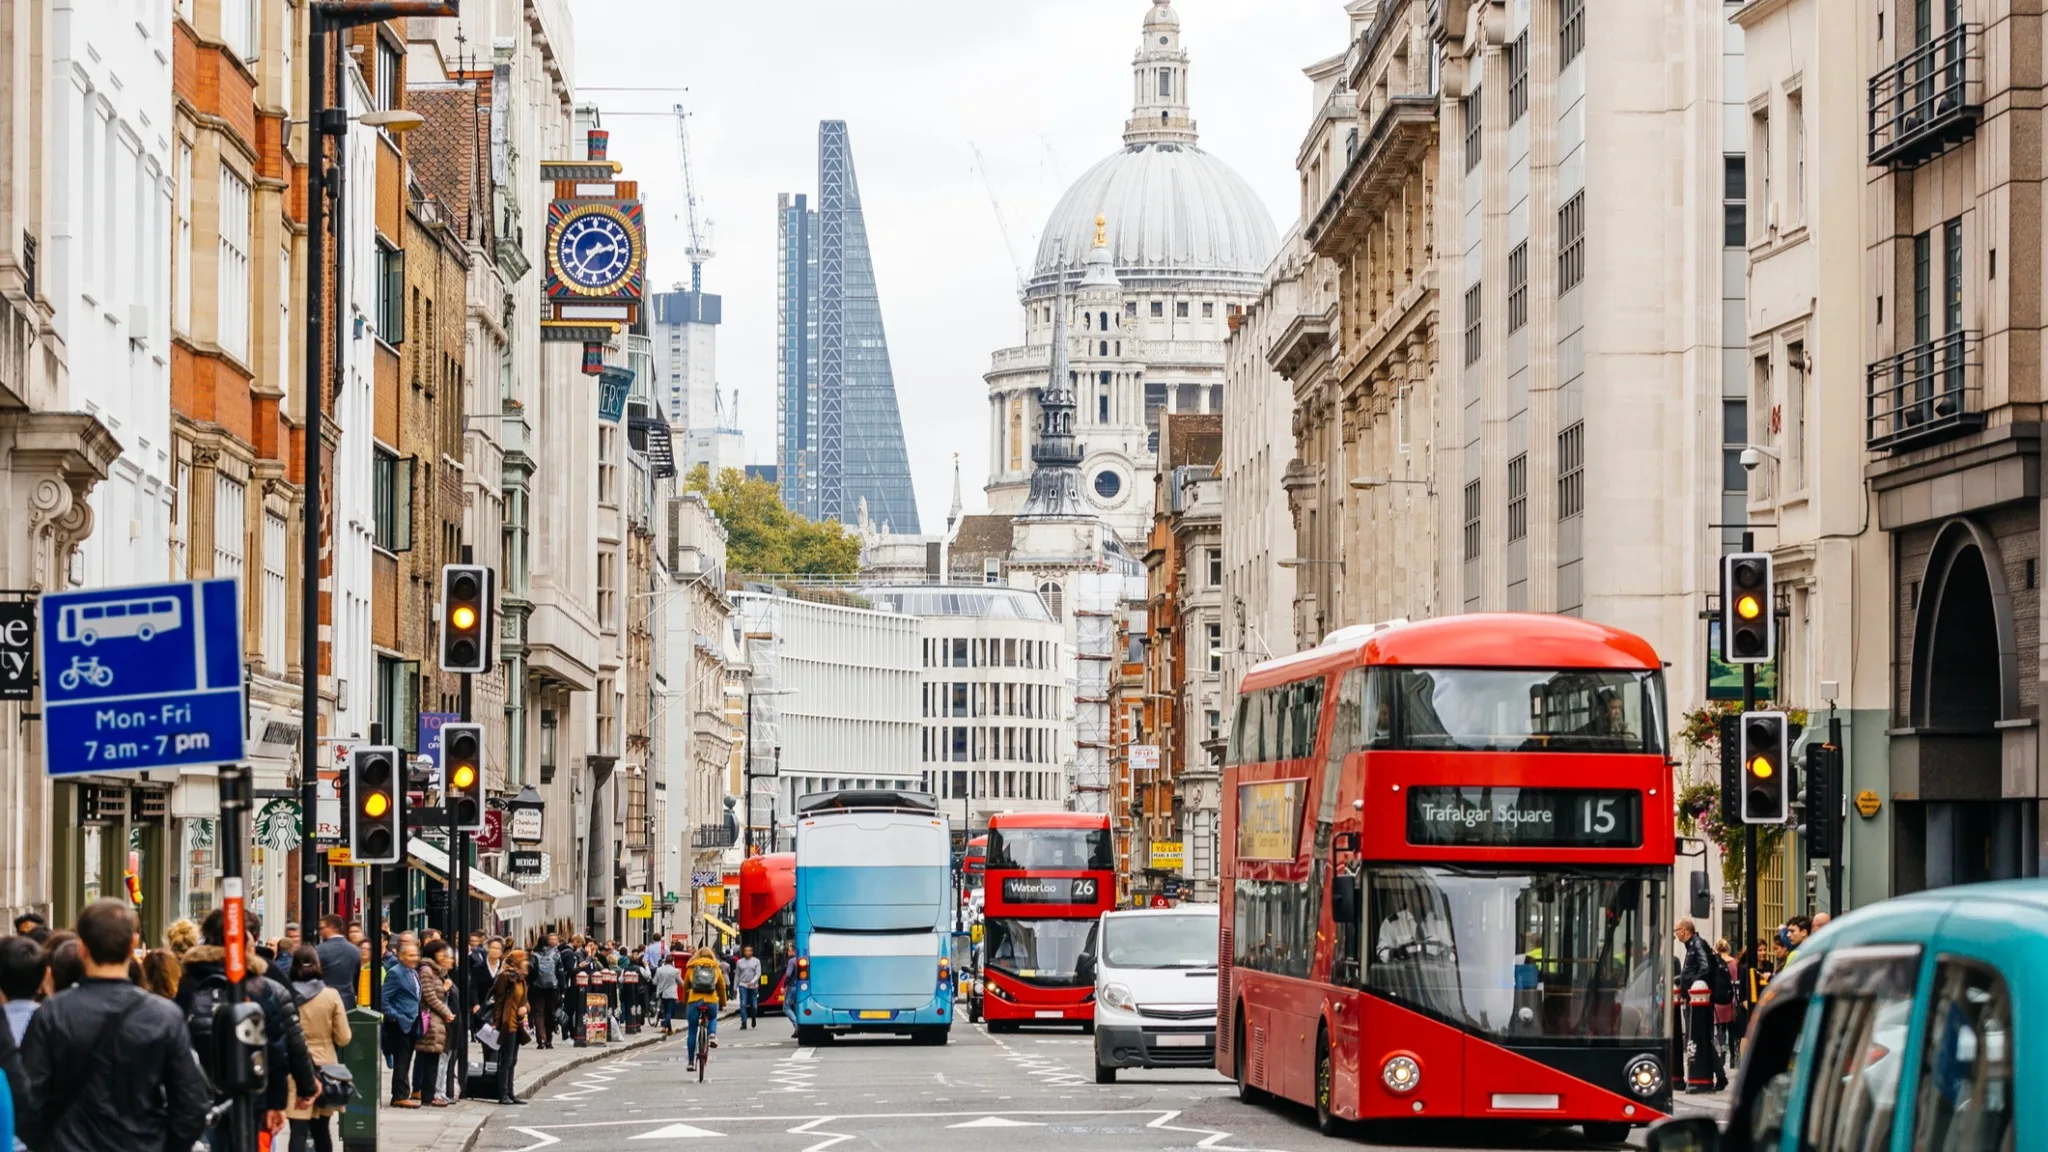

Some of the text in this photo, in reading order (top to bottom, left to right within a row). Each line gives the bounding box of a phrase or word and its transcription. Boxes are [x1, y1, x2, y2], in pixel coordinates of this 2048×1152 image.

[1423, 799, 1616, 833] Trafalgar Square 15
[515, 858, 539, 867] MEXICAN
[1010, 880, 1094, 896] Waterloo 26
